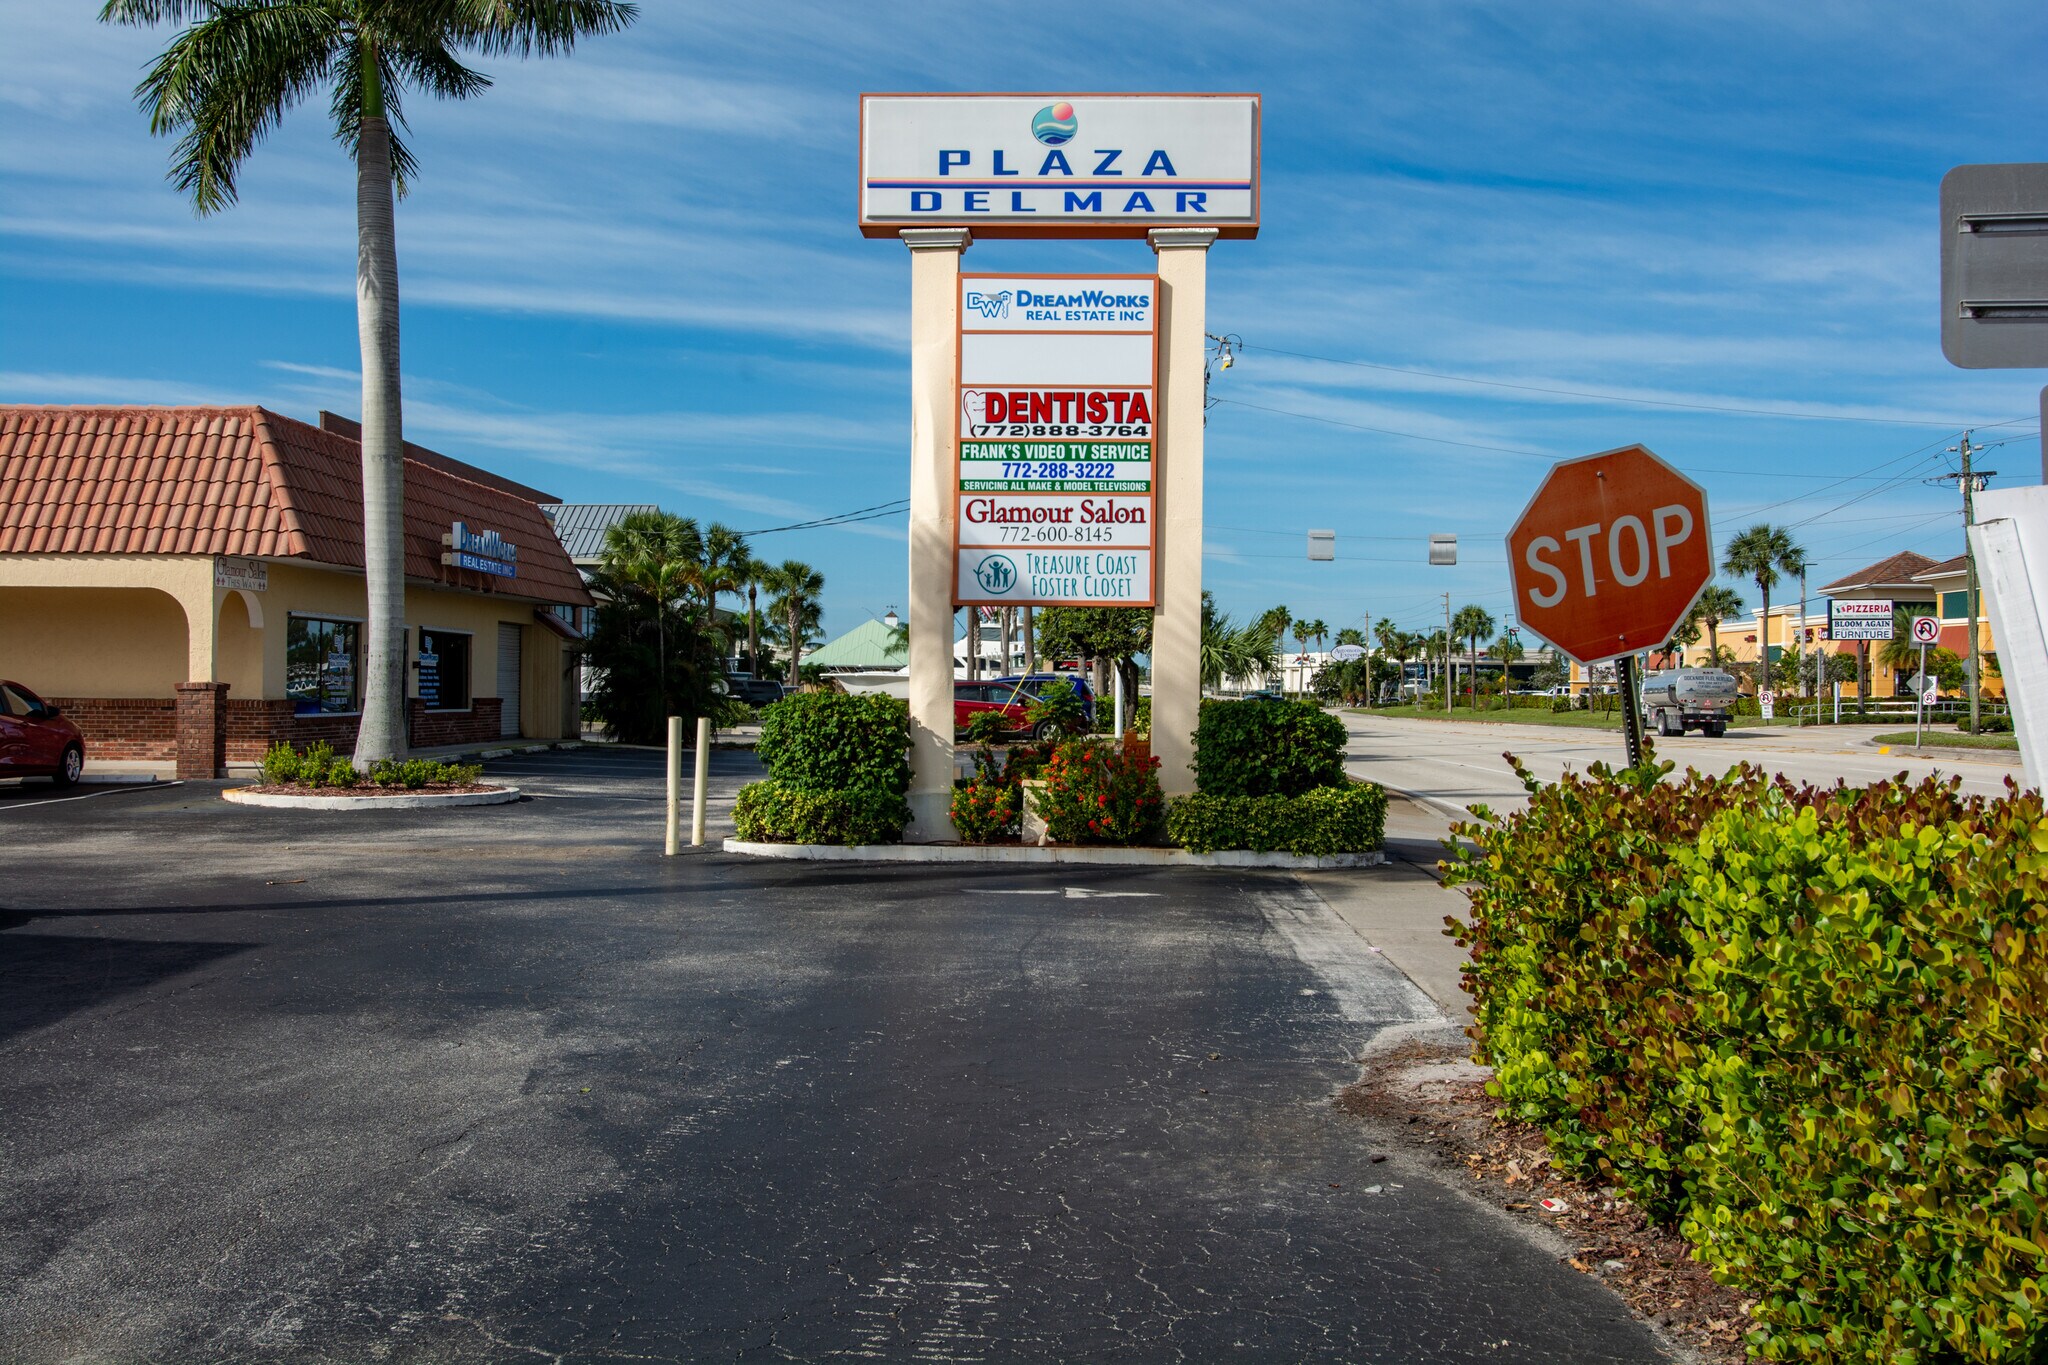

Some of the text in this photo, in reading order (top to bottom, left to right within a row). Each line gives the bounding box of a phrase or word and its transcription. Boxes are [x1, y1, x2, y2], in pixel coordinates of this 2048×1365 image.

[938, 149, 1178, 176] PLAZA
[1016, 290, 1150, 308] DREAMWORKS
[1026, 310, 1145, 321] REAL ESTATE INC
[985, 391, 1152, 424] DENTISTA
[970, 424, 1149, 438] (772)888-3764
[962, 443, 1149, 460] FRANK'S VIDEO TV SERVICE
[1001, 462, 1115, 479] 772-288-3222
[964, 481, 1147, 492] SERVICING ALL MAKE & MODEL TELEVISIONS
[965, 498, 1147, 524] Glamour Salon
[1000, 526, 1113, 542] 772-600-8145
[1026, 553, 1137, 575] TREASURE COAST
[1525, 503, 1694, 609] STOP
[463, 555, 513, 576] REAL ESTATE INC
[241, 577, 257, 590] WAY
[1032, 575, 1132, 597] FOSTER CLOSET
[1846, 604, 1891, 613] PIZZERIA
[1834, 620, 1891, 628] BLOOM AGAIN
[1834, 630, 1890, 639] FURNITURE
